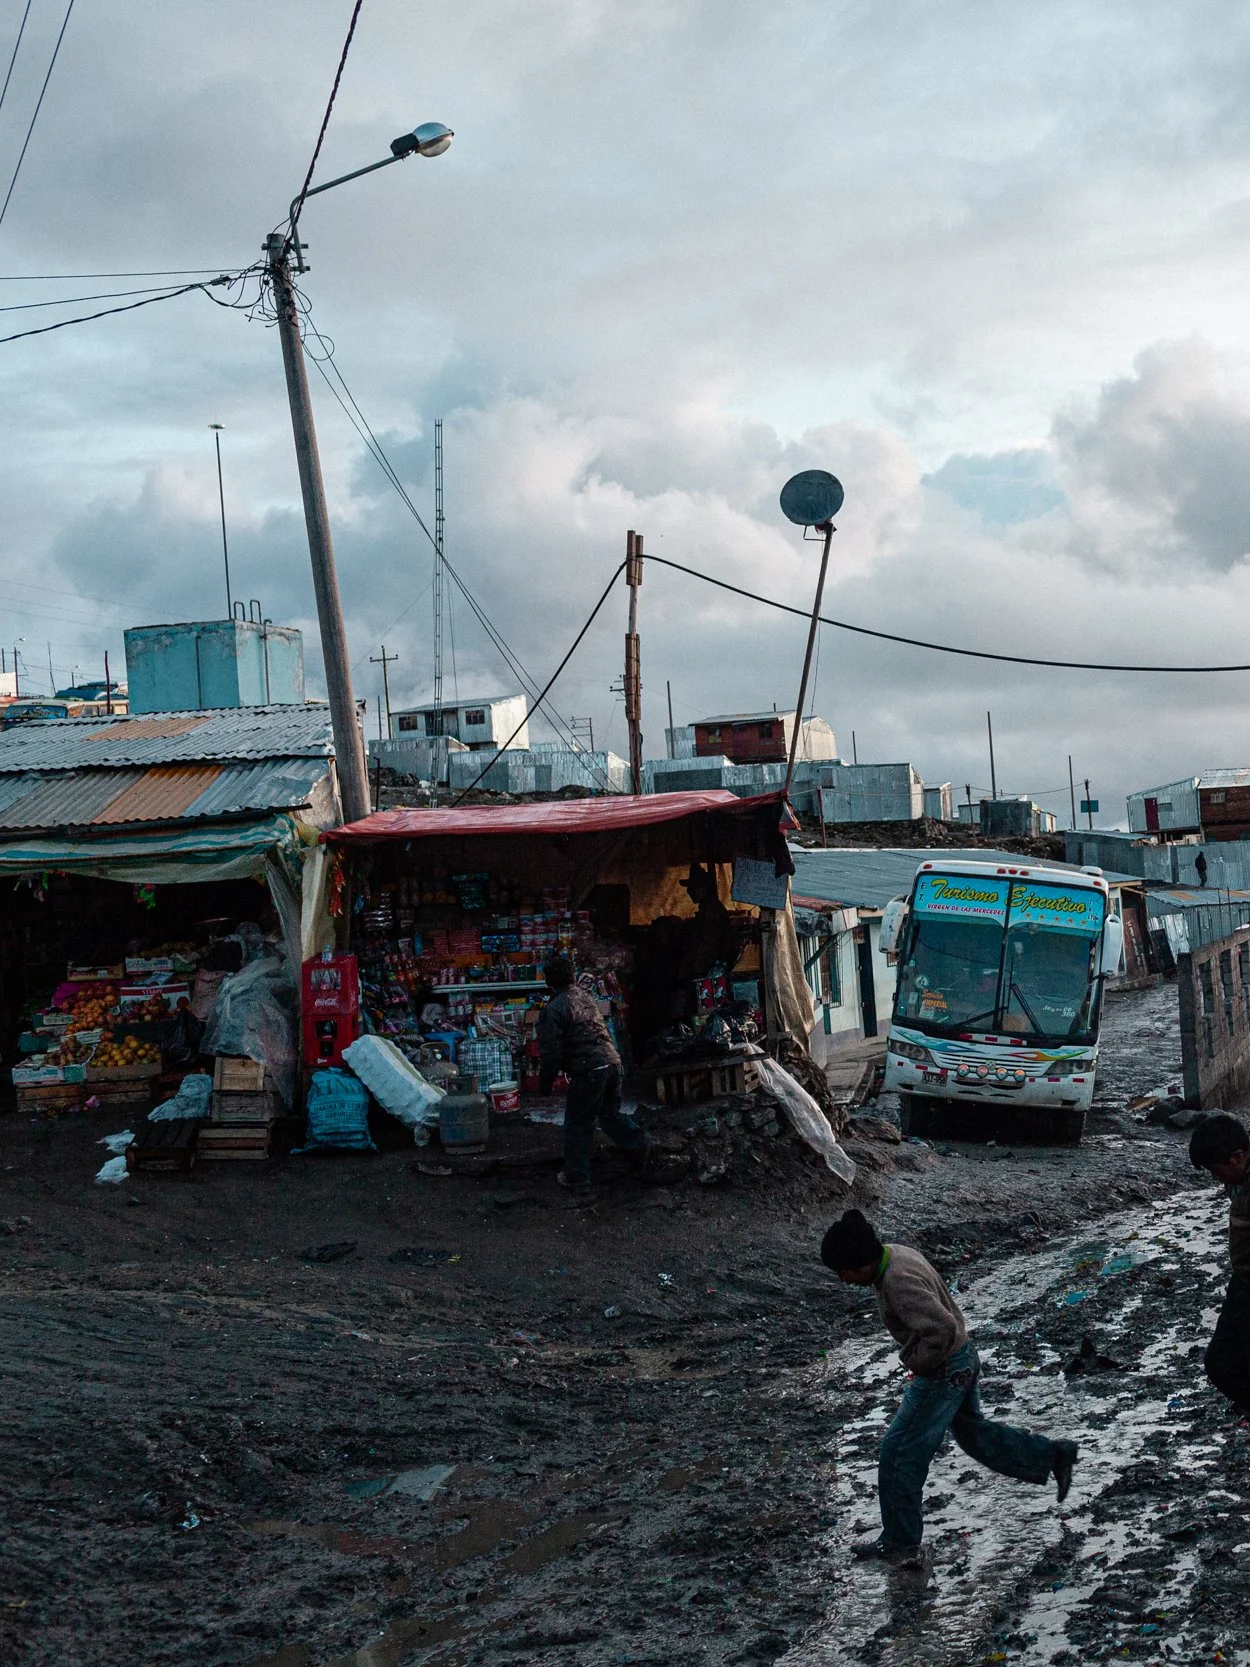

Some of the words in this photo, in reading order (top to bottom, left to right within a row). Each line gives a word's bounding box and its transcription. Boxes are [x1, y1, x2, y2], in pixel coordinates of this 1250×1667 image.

[931, 879, 999, 903] Turismo
[1005, 886, 1087, 914] Ejecutivo
[927, 903, 950, 911] VIRGEN
[972, 907, 1005, 916] MERCEDES
